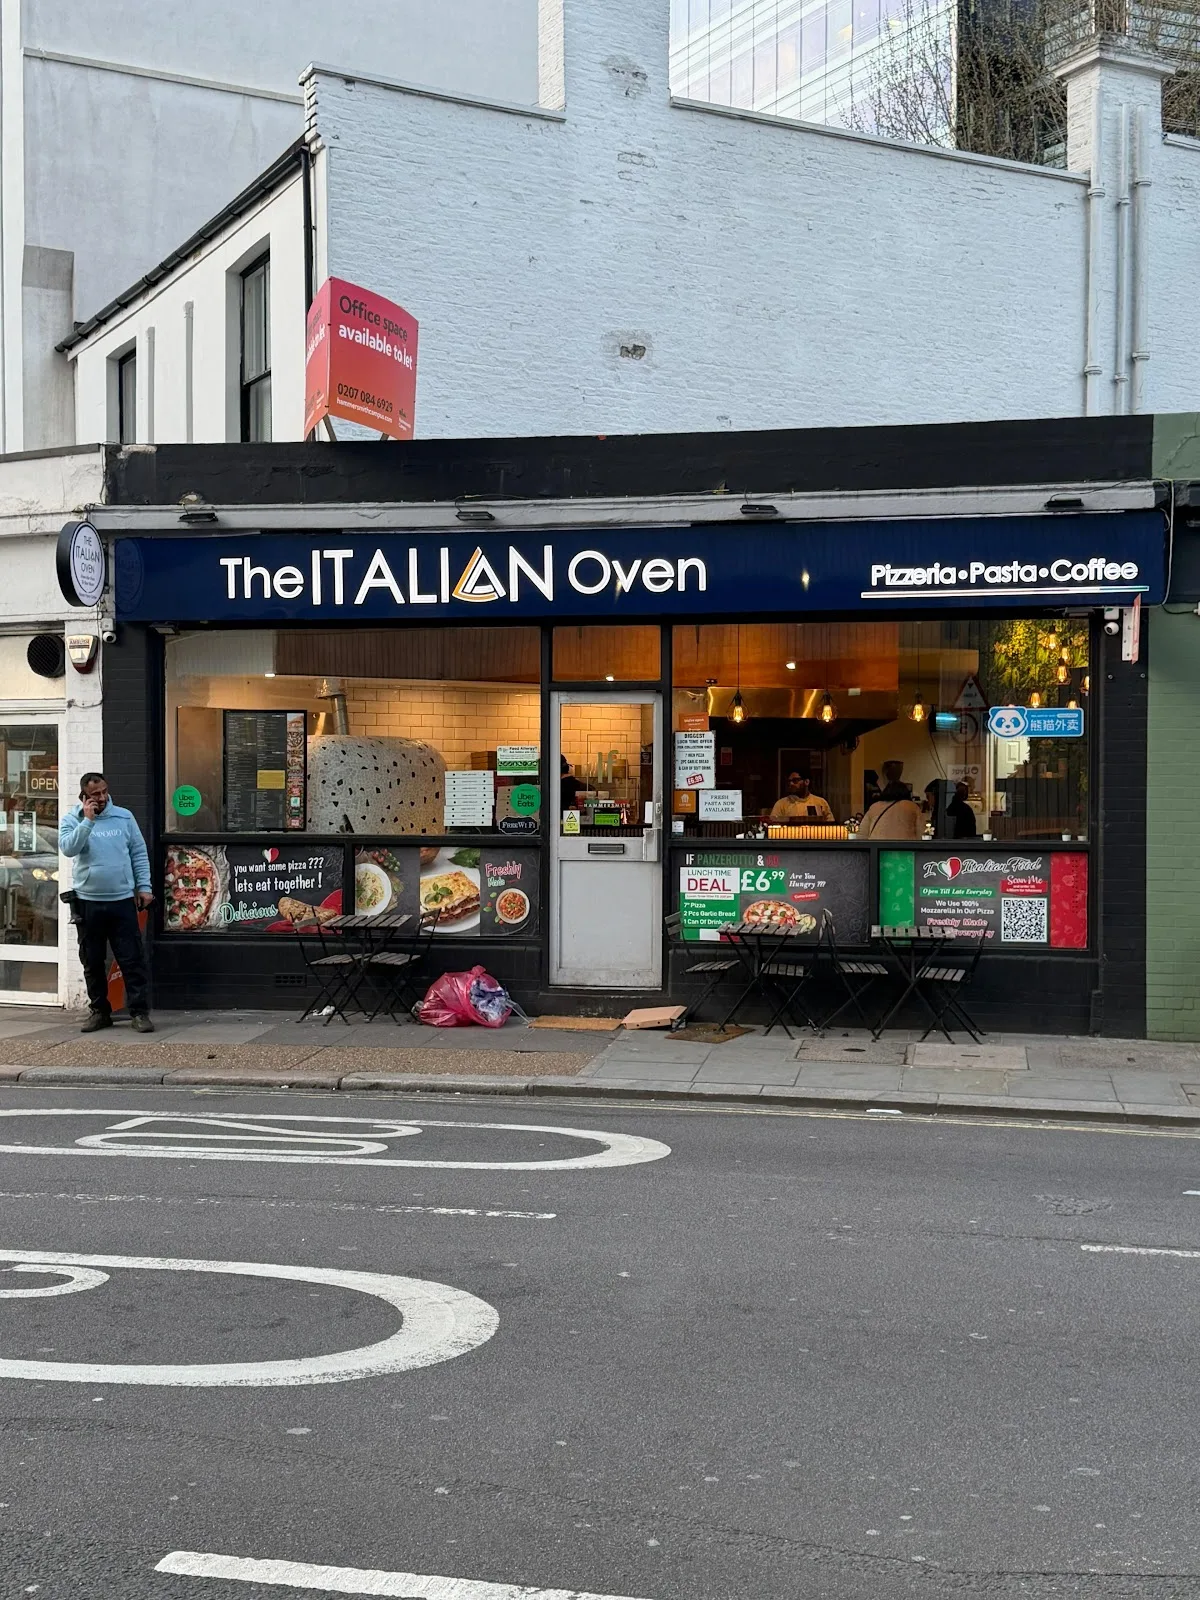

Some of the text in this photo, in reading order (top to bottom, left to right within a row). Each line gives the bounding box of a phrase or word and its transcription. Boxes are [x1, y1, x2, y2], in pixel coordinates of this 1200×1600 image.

[339, 295, 408, 342] Office space
[339, 324, 393, 357] available
[393, 344, 403, 363] to
[403, 347, 413, 370] let
[337, 382, 359, 400] 0207
[360, 391, 376, 406] 084
[336, 398, 393, 424] hammersmithcampus.com
[83, 535, 93, 547] THE
[75, 545, 100, 563] ITALIAN
[80, 562, 95, 574] OVEN
[219, 545, 707, 606] The ITALIAN Oven
[871, 557, 1139, 586] Pizzeria Pasta Coffee
[1030, 719, 1079, 731] 熊猫外卖
[31, 778, 58, 791] OPEN
[234, 856, 324, 876] you want some pizza ???
[685, 853, 695, 865] IF
[697, 854, 755, 865] PANZEROTTO
[756, 854, 764, 866] &
[961, 859, 1010, 875] Italian
[1006, 856, 1042, 873] Food
[485, 860, 522, 879] Freshly
[714, 869, 732, 877] TIME
[789, 872, 816, 880] Are You
[234, 872, 323, 894] lets eat together !
[487, 876, 506, 888] Made
[687, 878, 732, 892] DEAL
[740, 870, 785, 892] £6.99
[788, 880, 816, 890] Hungry
[1006, 874, 1043, 886] Scan Me
[922, 888, 939, 896] Open
[965, 888, 993, 896] Everyday
[219, 900, 279, 924] Delicious
[926, 917, 988, 927] Freshly Made
